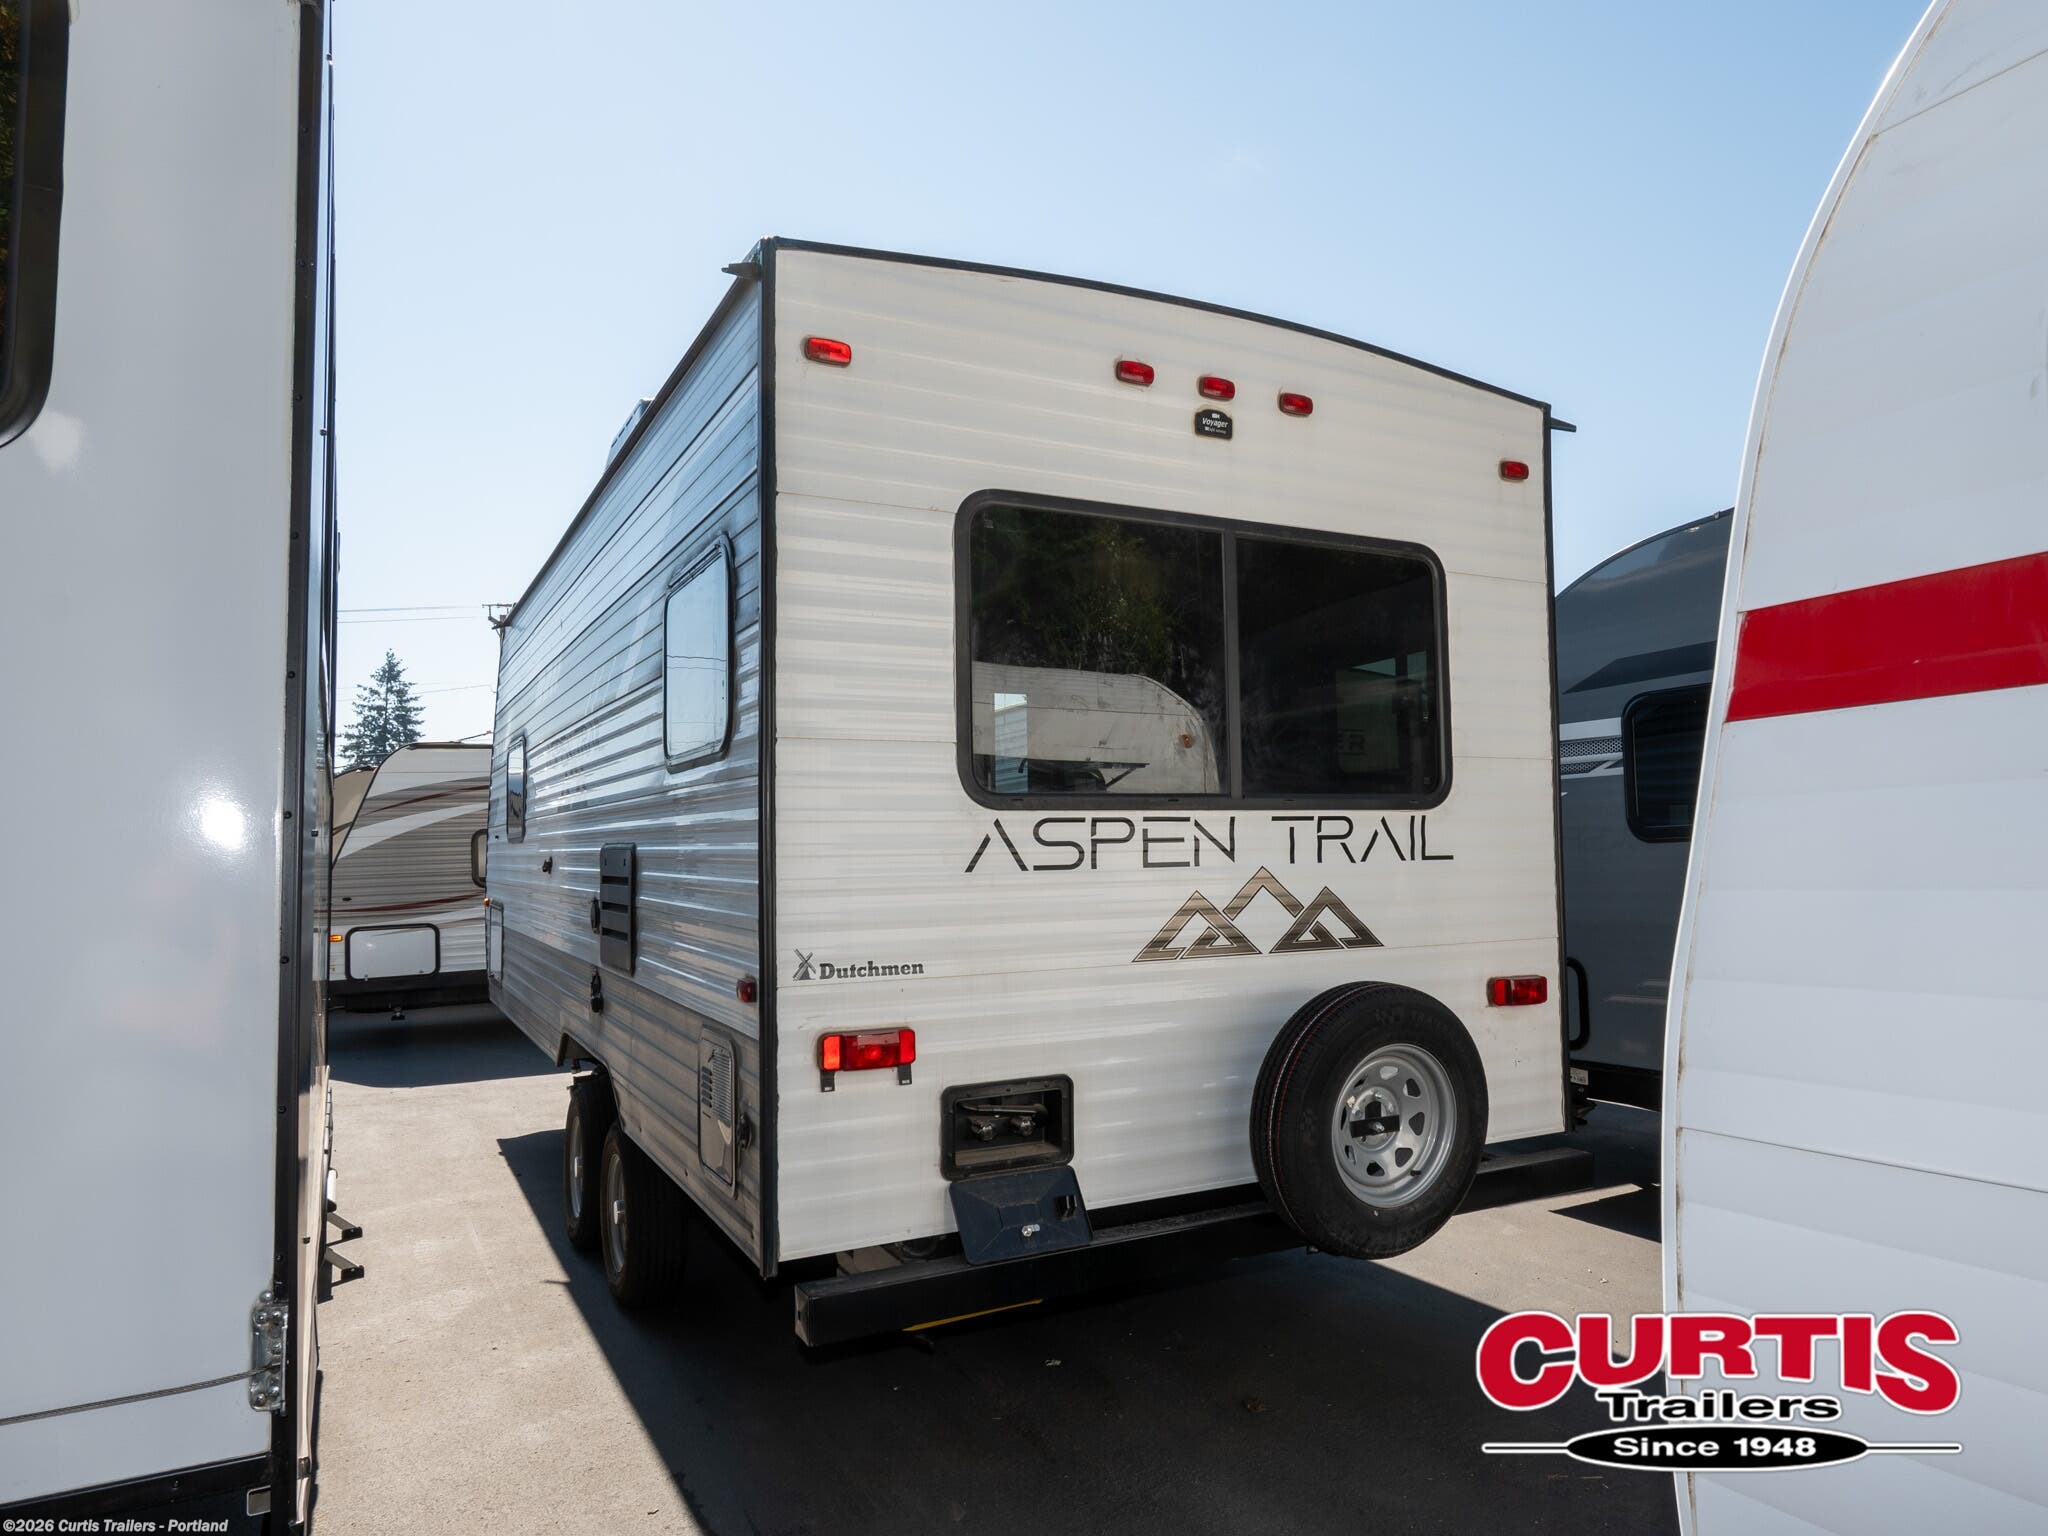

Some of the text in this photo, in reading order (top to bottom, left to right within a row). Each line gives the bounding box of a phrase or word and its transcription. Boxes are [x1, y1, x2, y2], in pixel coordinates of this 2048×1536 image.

[1202, 417, 1229, 429] Voyager
[965, 815, 1455, 873] ASPEN TRAIL
[819, 961, 925, 980] Dutchmen
